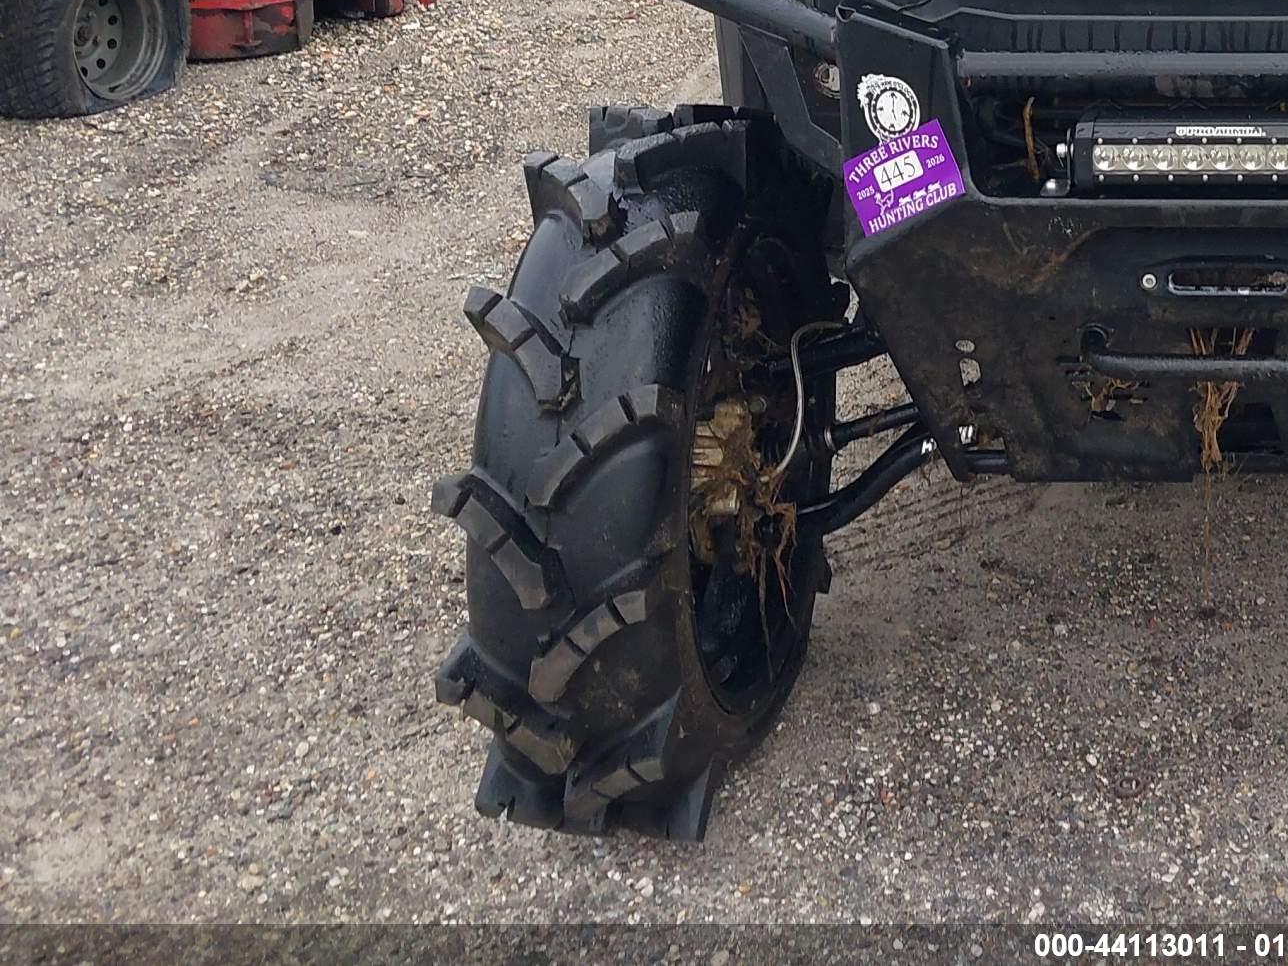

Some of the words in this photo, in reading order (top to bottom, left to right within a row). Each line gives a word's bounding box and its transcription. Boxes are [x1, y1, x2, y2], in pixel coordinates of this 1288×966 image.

[848, 145, 889, 184] THREE
[889, 134, 939, 155] RIVERS
[880, 155, 916, 187] 445
[925, 153, 945, 169] 2026
[856, 185, 875, 201] 2025
[868, 199, 924, 234] HUNTING
[925, 182, 957, 207] CLUB
